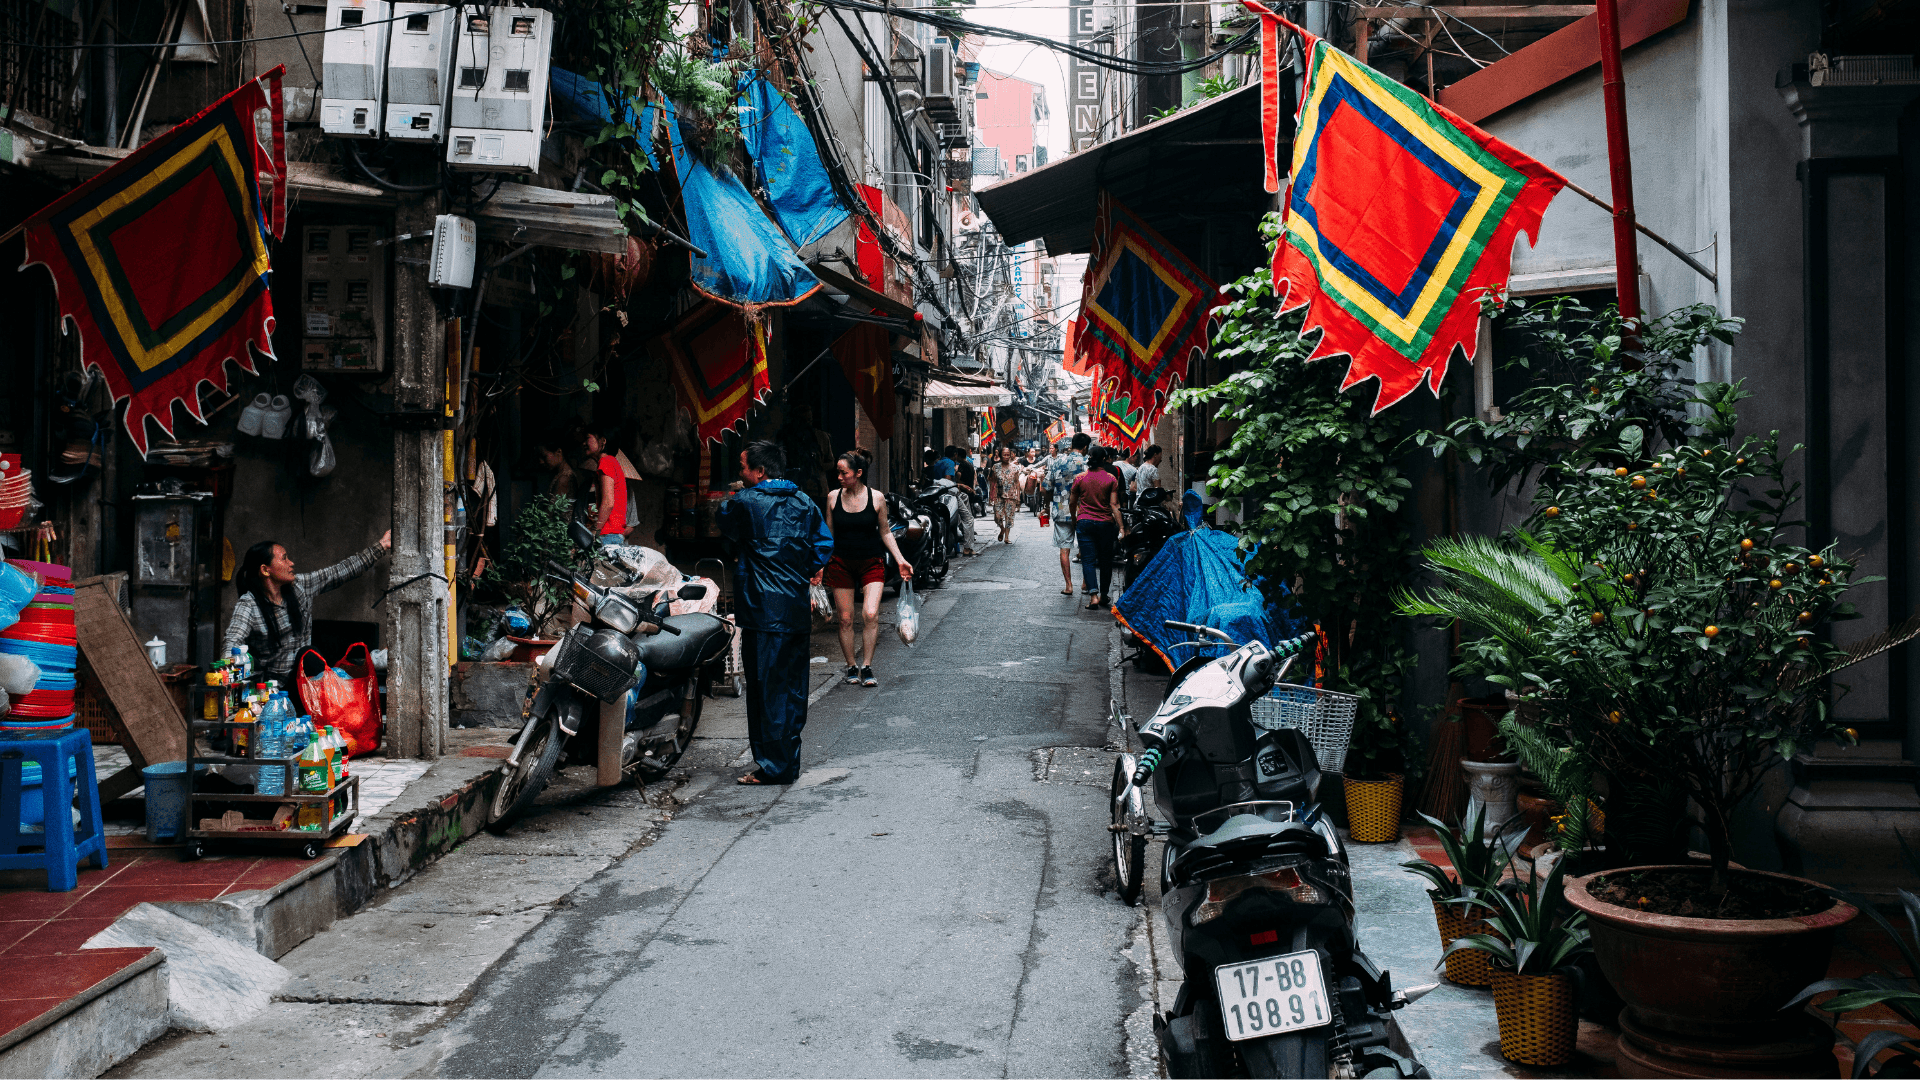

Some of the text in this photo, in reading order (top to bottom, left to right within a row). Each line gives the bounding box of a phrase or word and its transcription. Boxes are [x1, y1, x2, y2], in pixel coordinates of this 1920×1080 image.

[1014, 255, 1023, 298] PHARMACY
[1233, 958, 1307, 999] 17-B8
[1230, 989, 1323, 1035] 198.91
